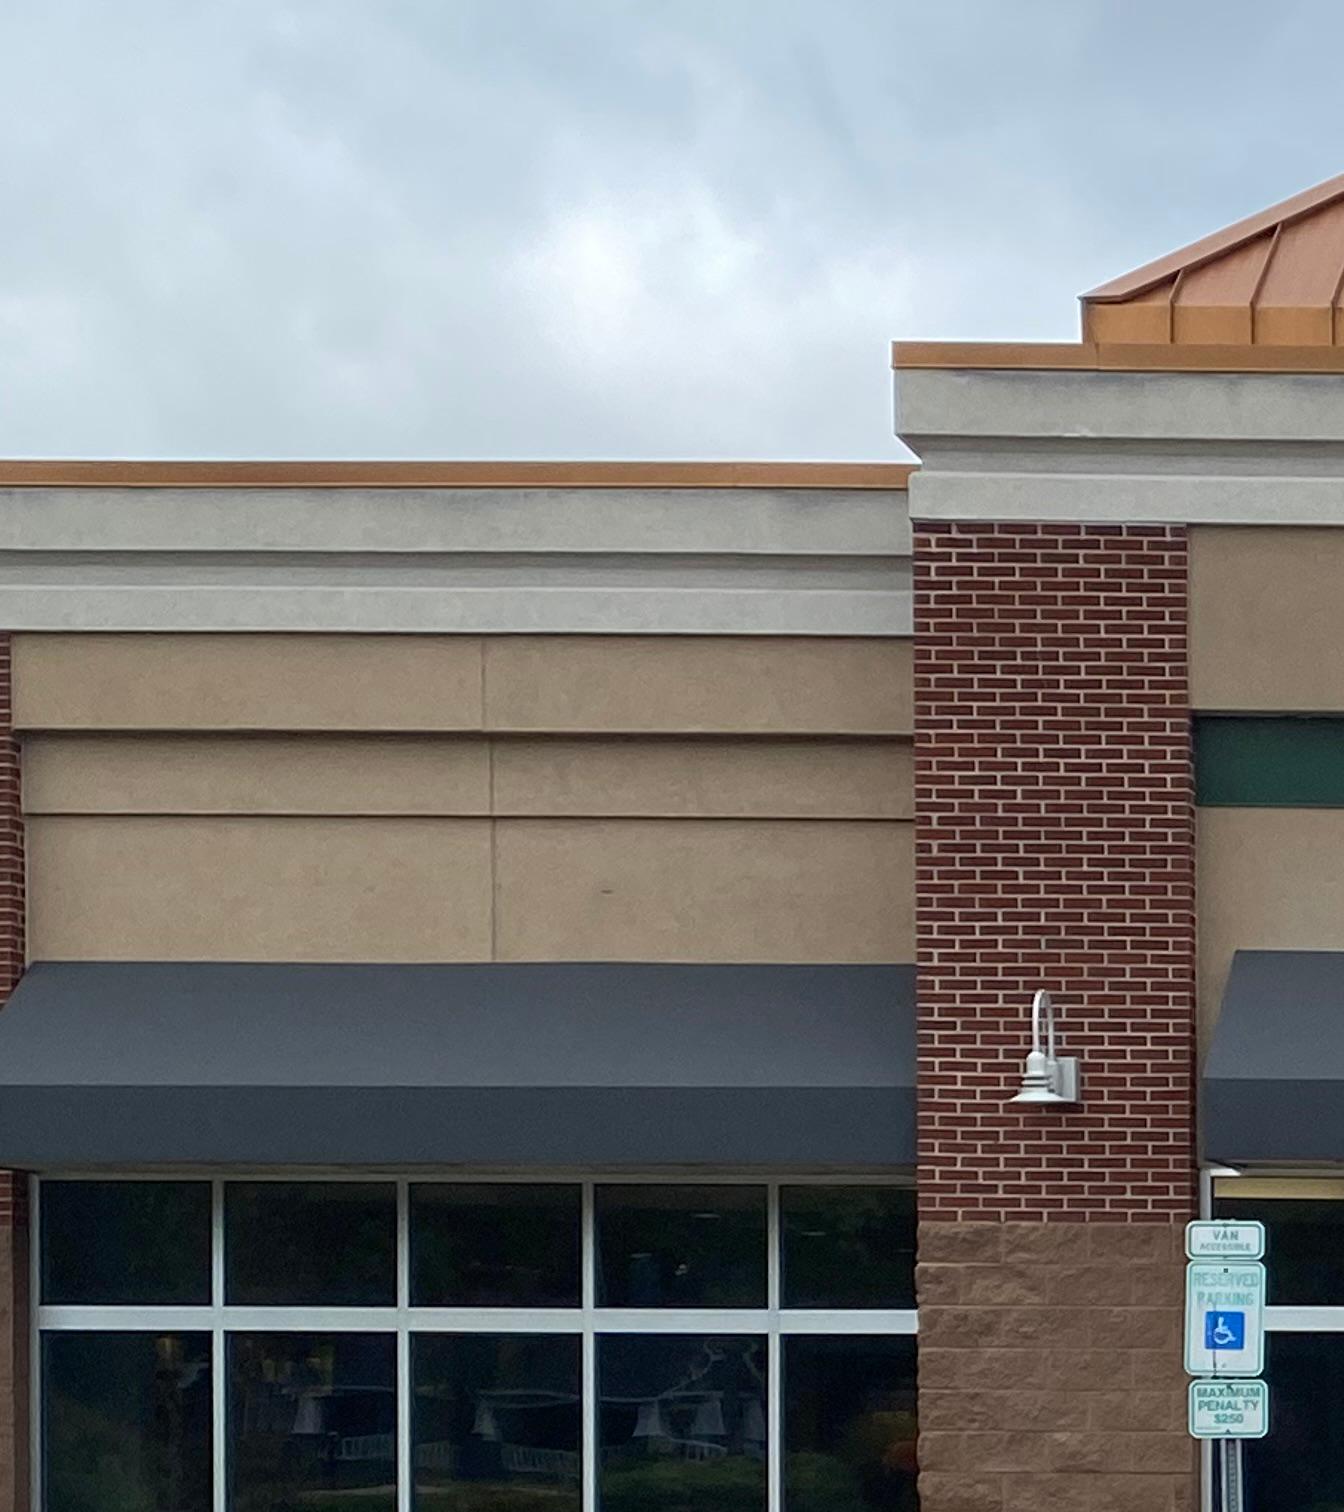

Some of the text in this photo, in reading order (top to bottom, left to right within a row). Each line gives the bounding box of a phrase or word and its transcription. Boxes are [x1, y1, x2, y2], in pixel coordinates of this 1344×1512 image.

[1213, 1230, 1239, 1240] VAN
[1194, 1272, 1259, 1287] RESERVED
[1197, 1292, 1254, 1306] PARKING
[1197, 1387, 1260, 1398] MAXIMUM
[1198, 1400, 1258, 1411] PENALTY
